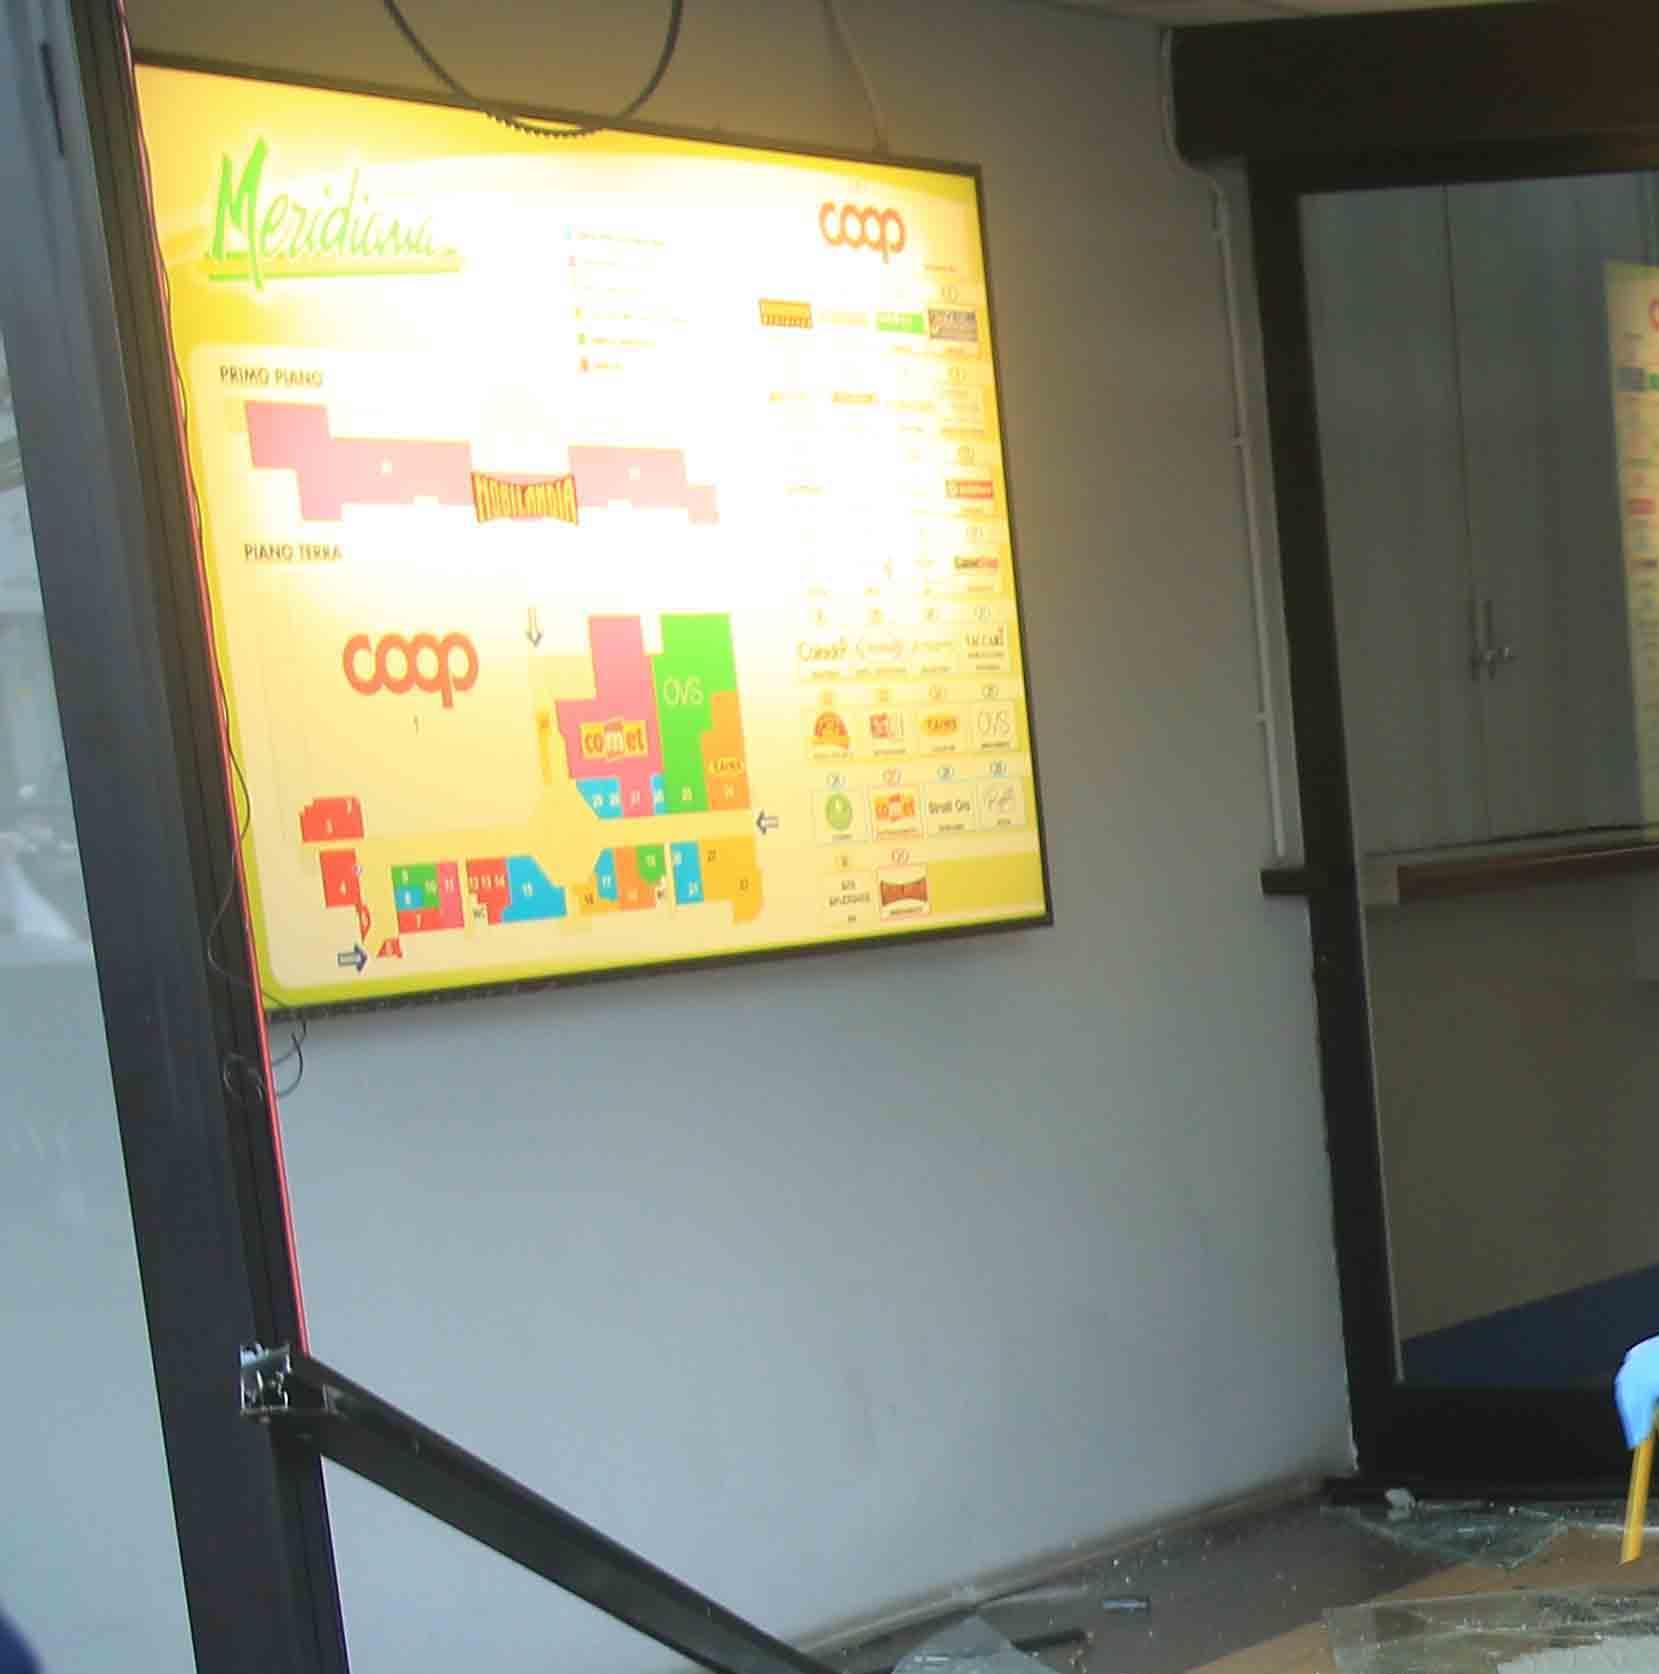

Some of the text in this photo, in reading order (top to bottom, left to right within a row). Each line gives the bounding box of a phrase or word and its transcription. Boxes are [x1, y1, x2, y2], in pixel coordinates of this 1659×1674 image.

[818, 201, 906, 263] coop
[219, 365, 324, 387] PRIMO PIANO
[243, 543, 342, 561] PIANO TERRA
[343, 633, 479, 708] coop
[663, 675, 705, 706] OVS
[583, 725, 645, 755] comet
